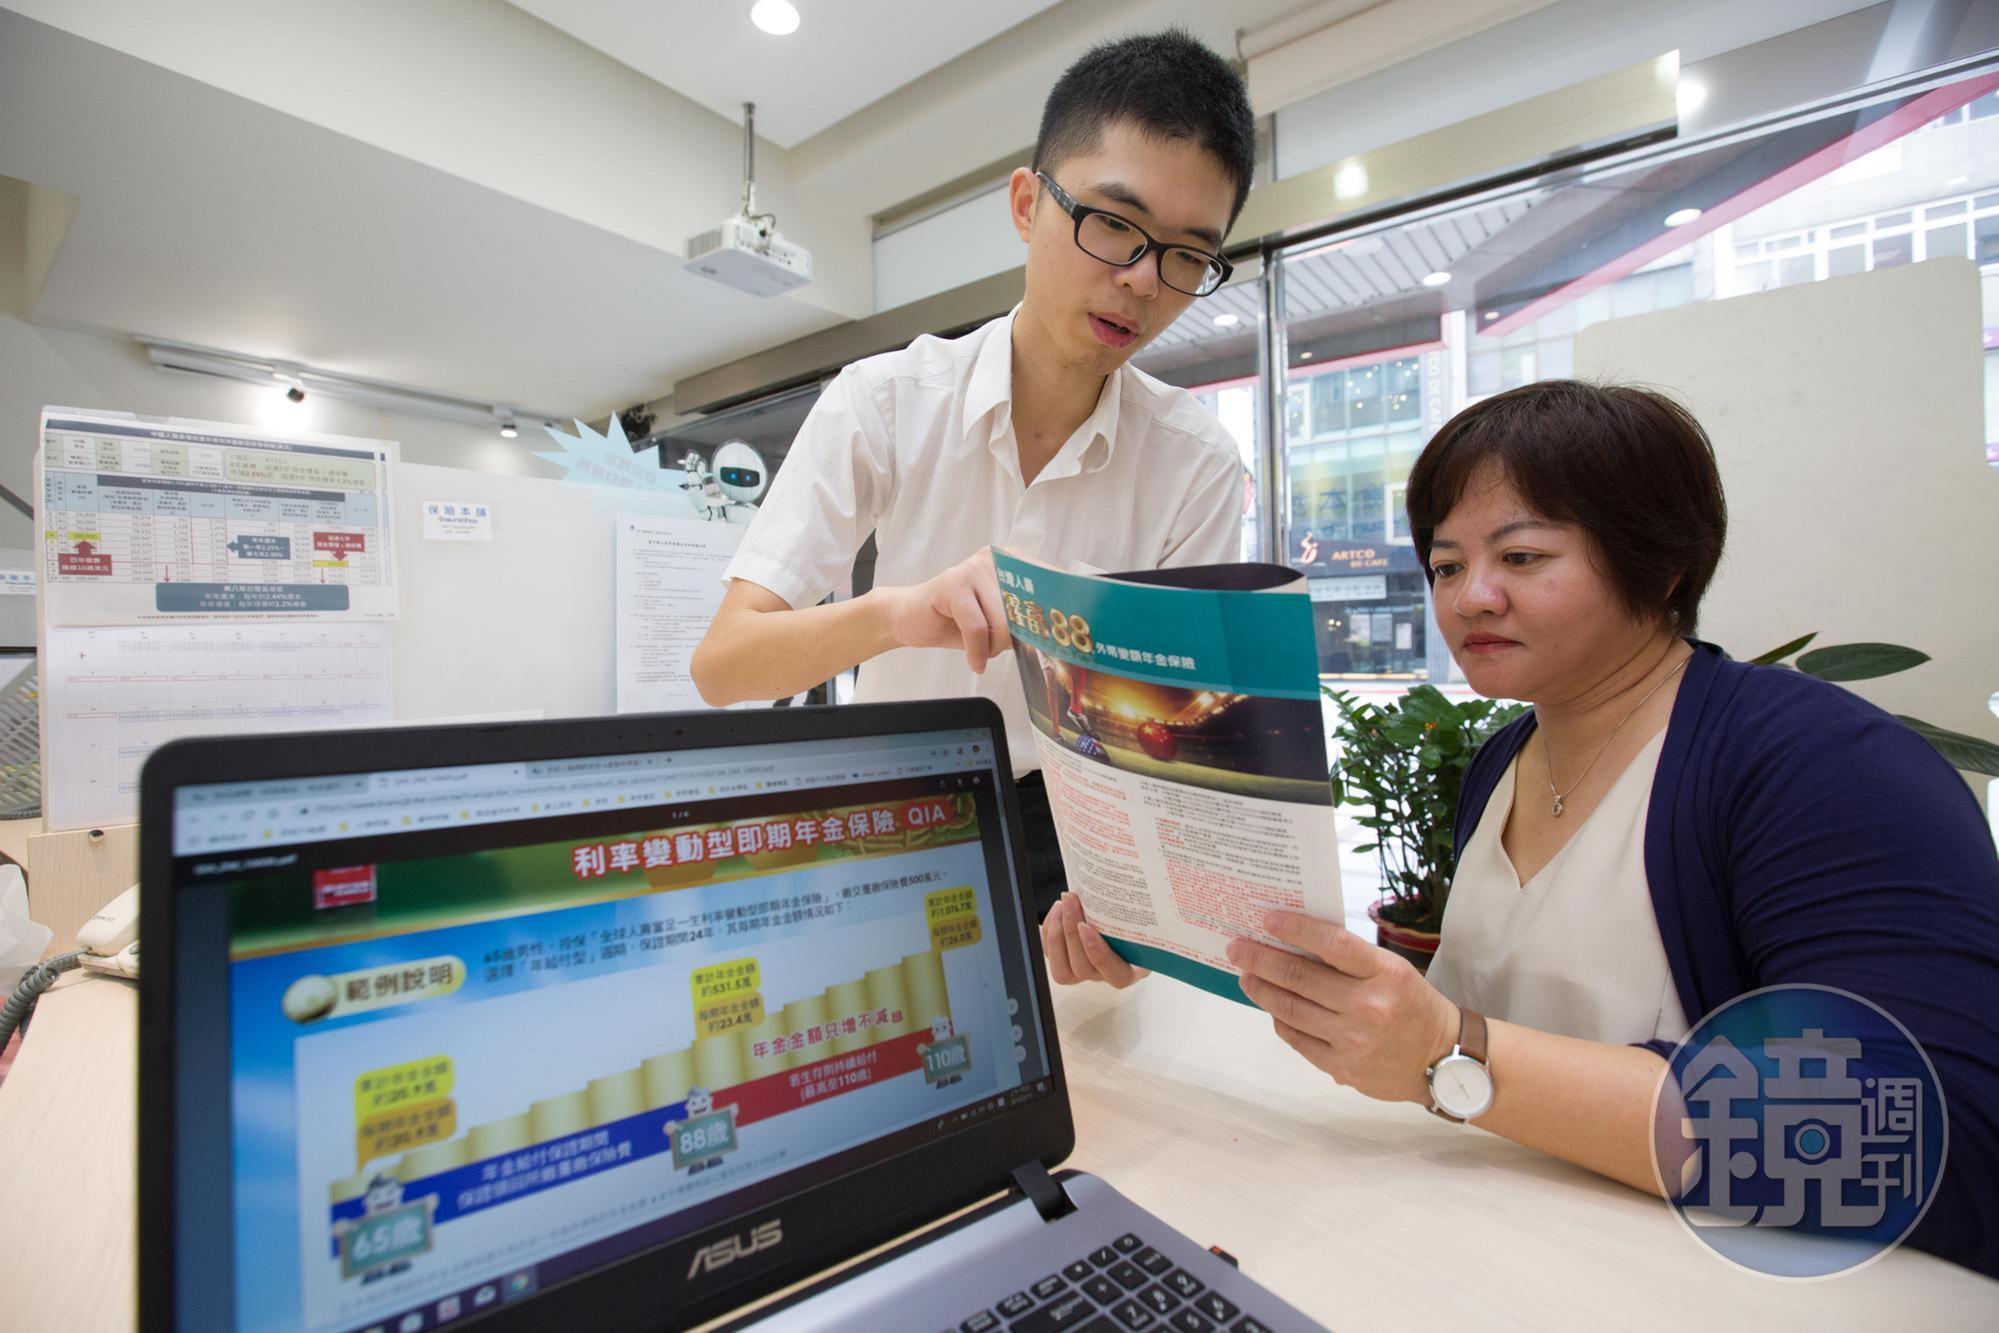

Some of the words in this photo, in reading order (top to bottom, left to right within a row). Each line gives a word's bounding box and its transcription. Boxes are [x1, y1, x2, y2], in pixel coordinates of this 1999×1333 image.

[1332, 548, 1376, 560] ARTCO
[574, 809, 895, 878] 利率變動型即期年金保險
[907, 804, 946, 826] QIA
[347, 962, 453, 1001] 範例說明
[926, 1045, 966, 1071] 110歲
[680, 1120, 730, 1154] 88歲
[687, 1218, 783, 1280] ASUS
